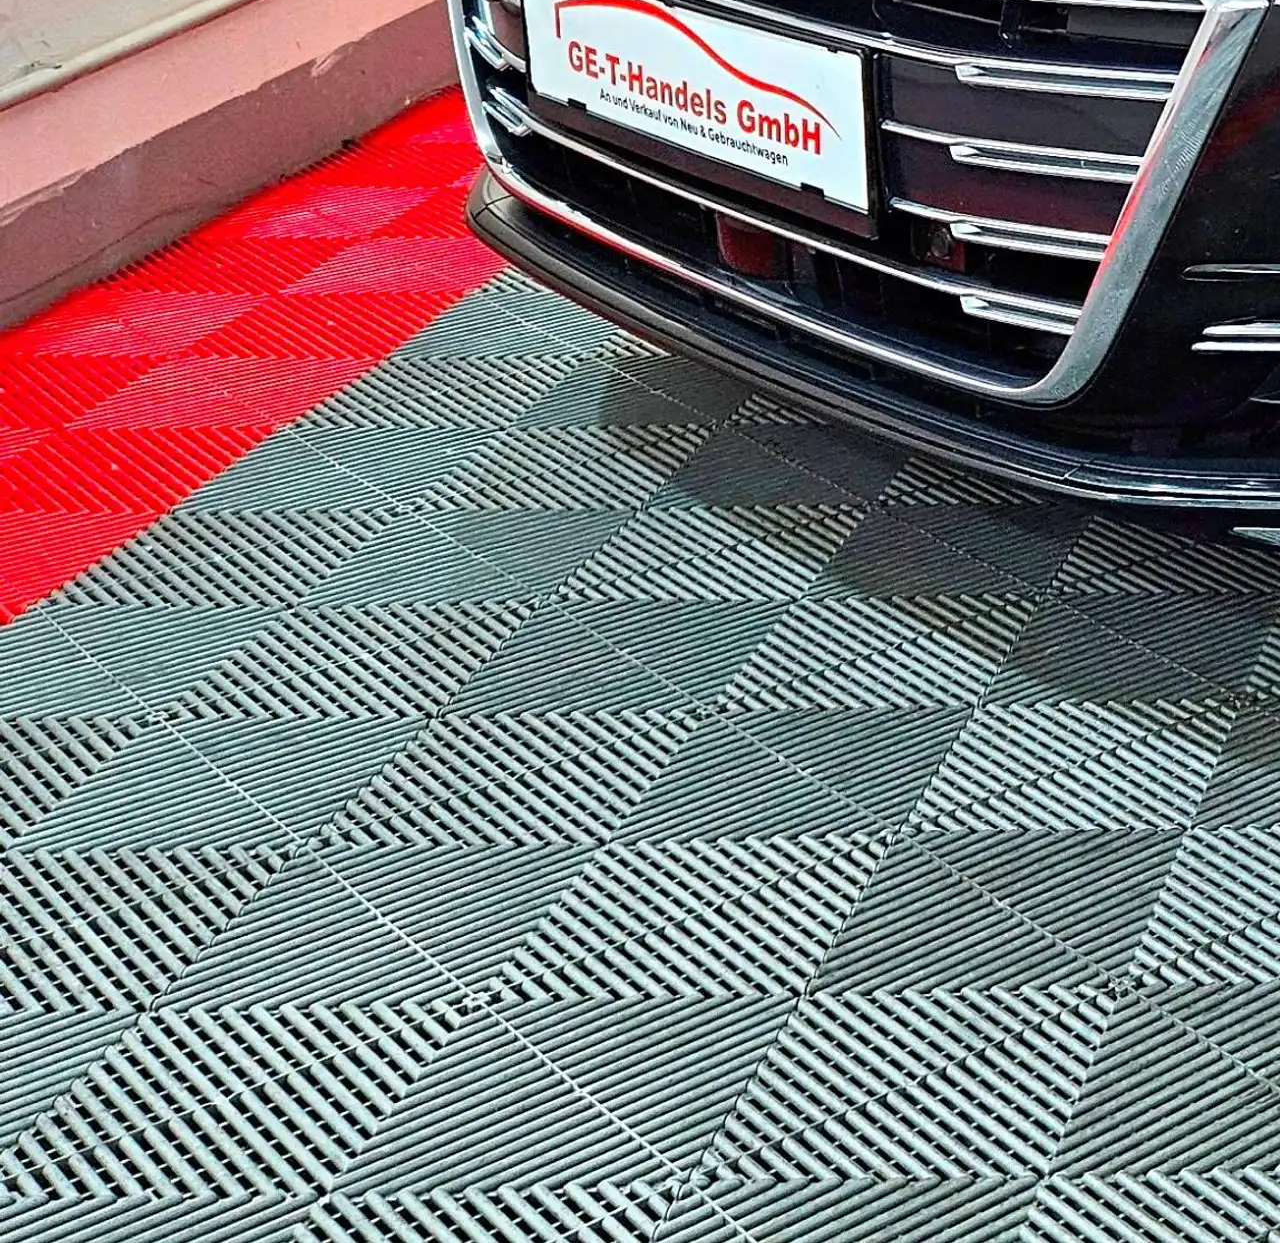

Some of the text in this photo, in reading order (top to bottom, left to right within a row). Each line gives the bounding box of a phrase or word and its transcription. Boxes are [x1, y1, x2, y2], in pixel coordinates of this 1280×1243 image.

[567, 40, 822, 155] GE-T-Handels GmbH
[599, 87, 789, 166] An und Verkauf von Neu & Gebrauchtwagen
